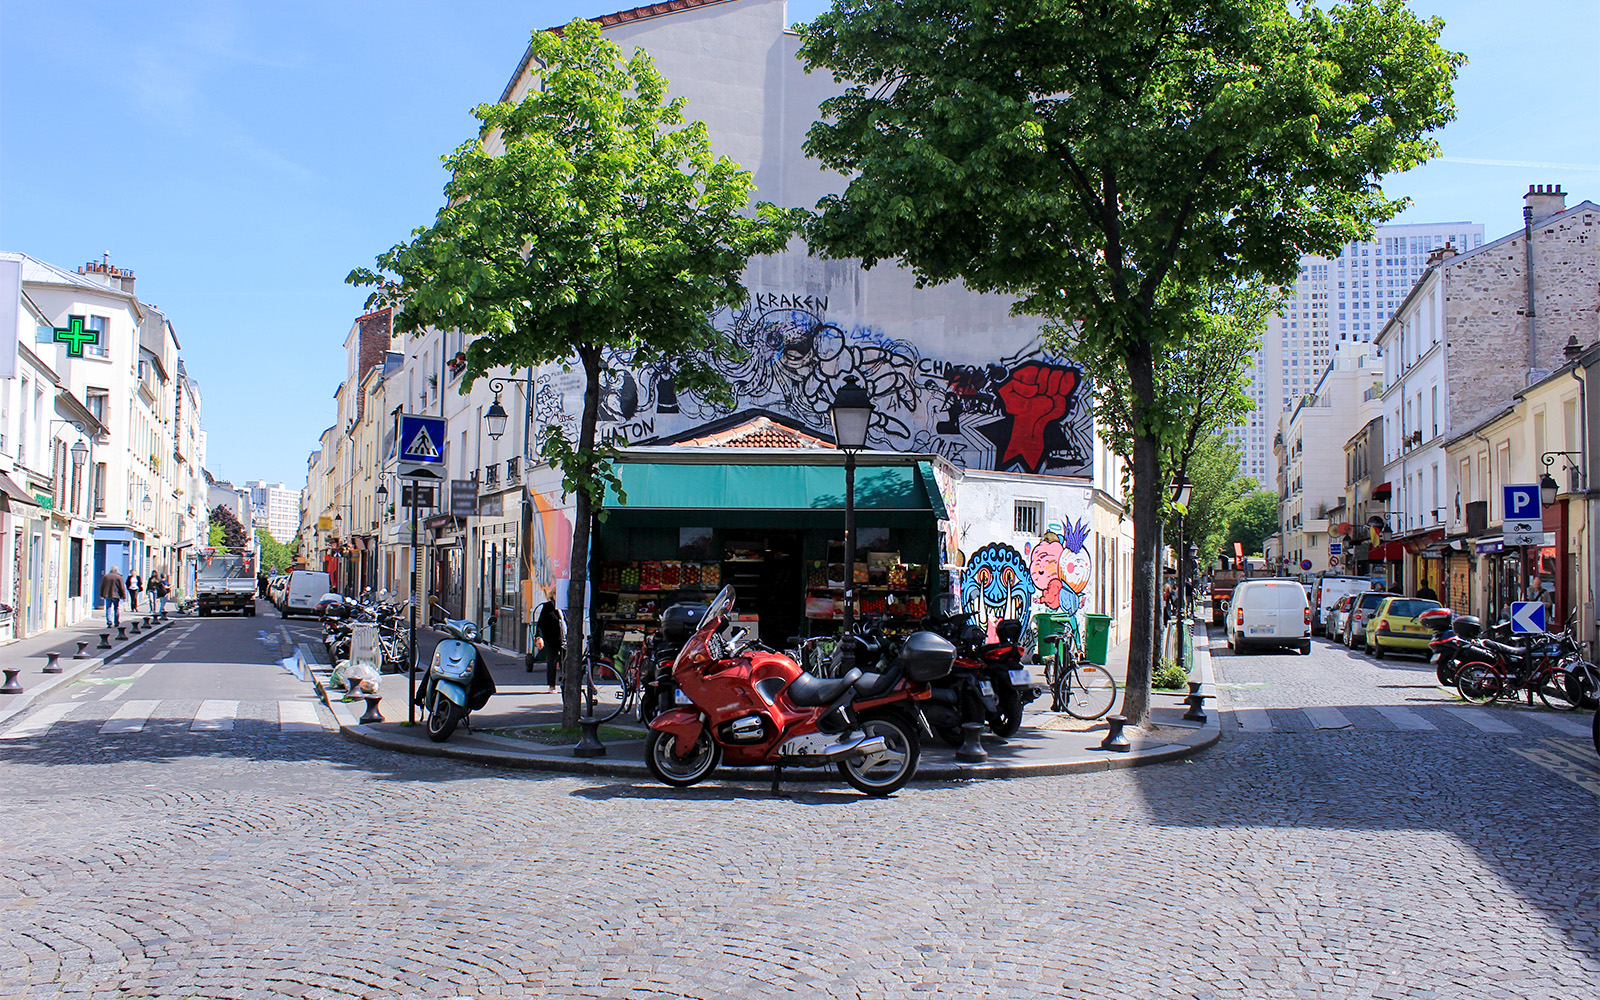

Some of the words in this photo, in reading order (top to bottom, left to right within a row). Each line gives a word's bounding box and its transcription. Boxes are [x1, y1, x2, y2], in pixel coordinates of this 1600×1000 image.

[755, 292, 829, 313] KRAKEN
[595, 417, 655, 447] HATON
[1513, 491, 1530, 514] P
